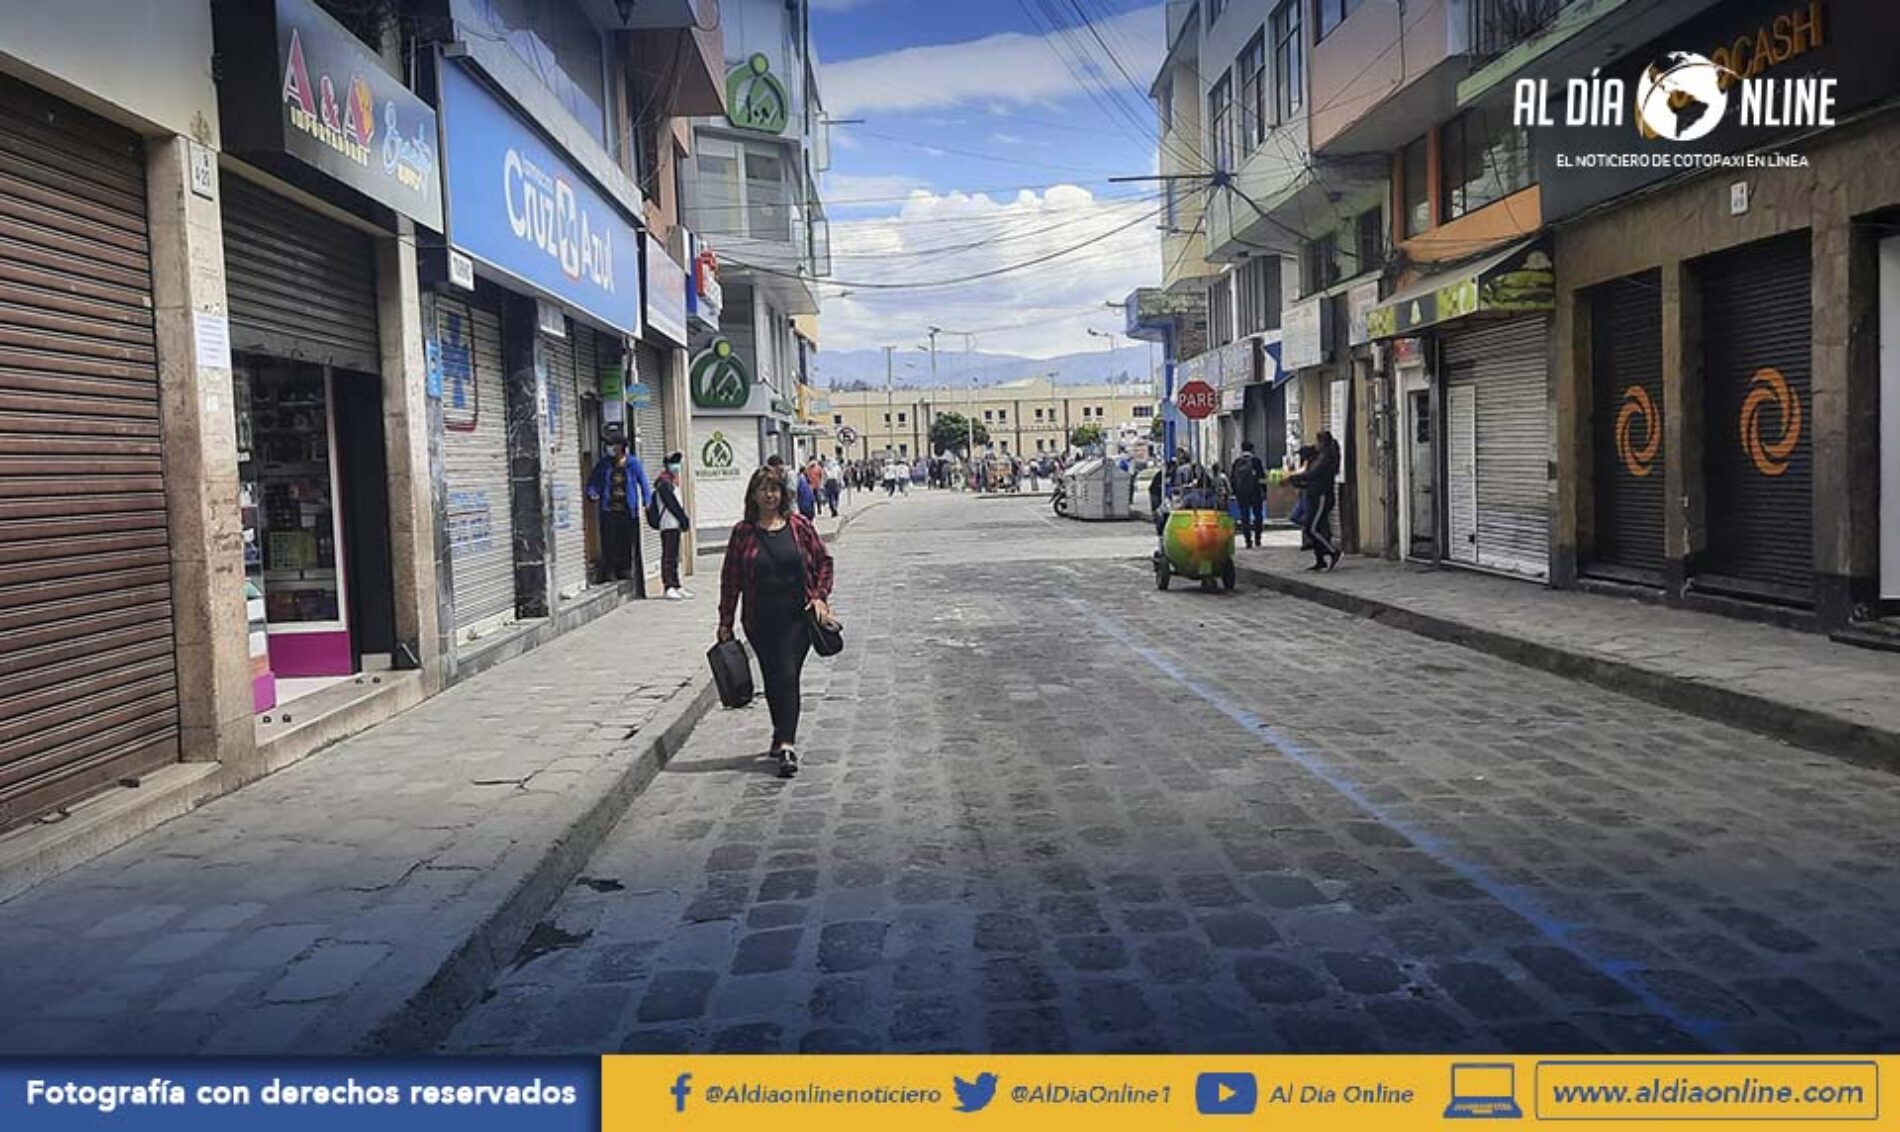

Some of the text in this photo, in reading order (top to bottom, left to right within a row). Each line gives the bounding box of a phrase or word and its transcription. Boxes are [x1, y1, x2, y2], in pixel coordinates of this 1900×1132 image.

[283, 27, 318, 121] A
[320, 74, 342, 134] &
[504, 148, 558, 257] Cruz
[1179, 392, 1214, 408] PARE
